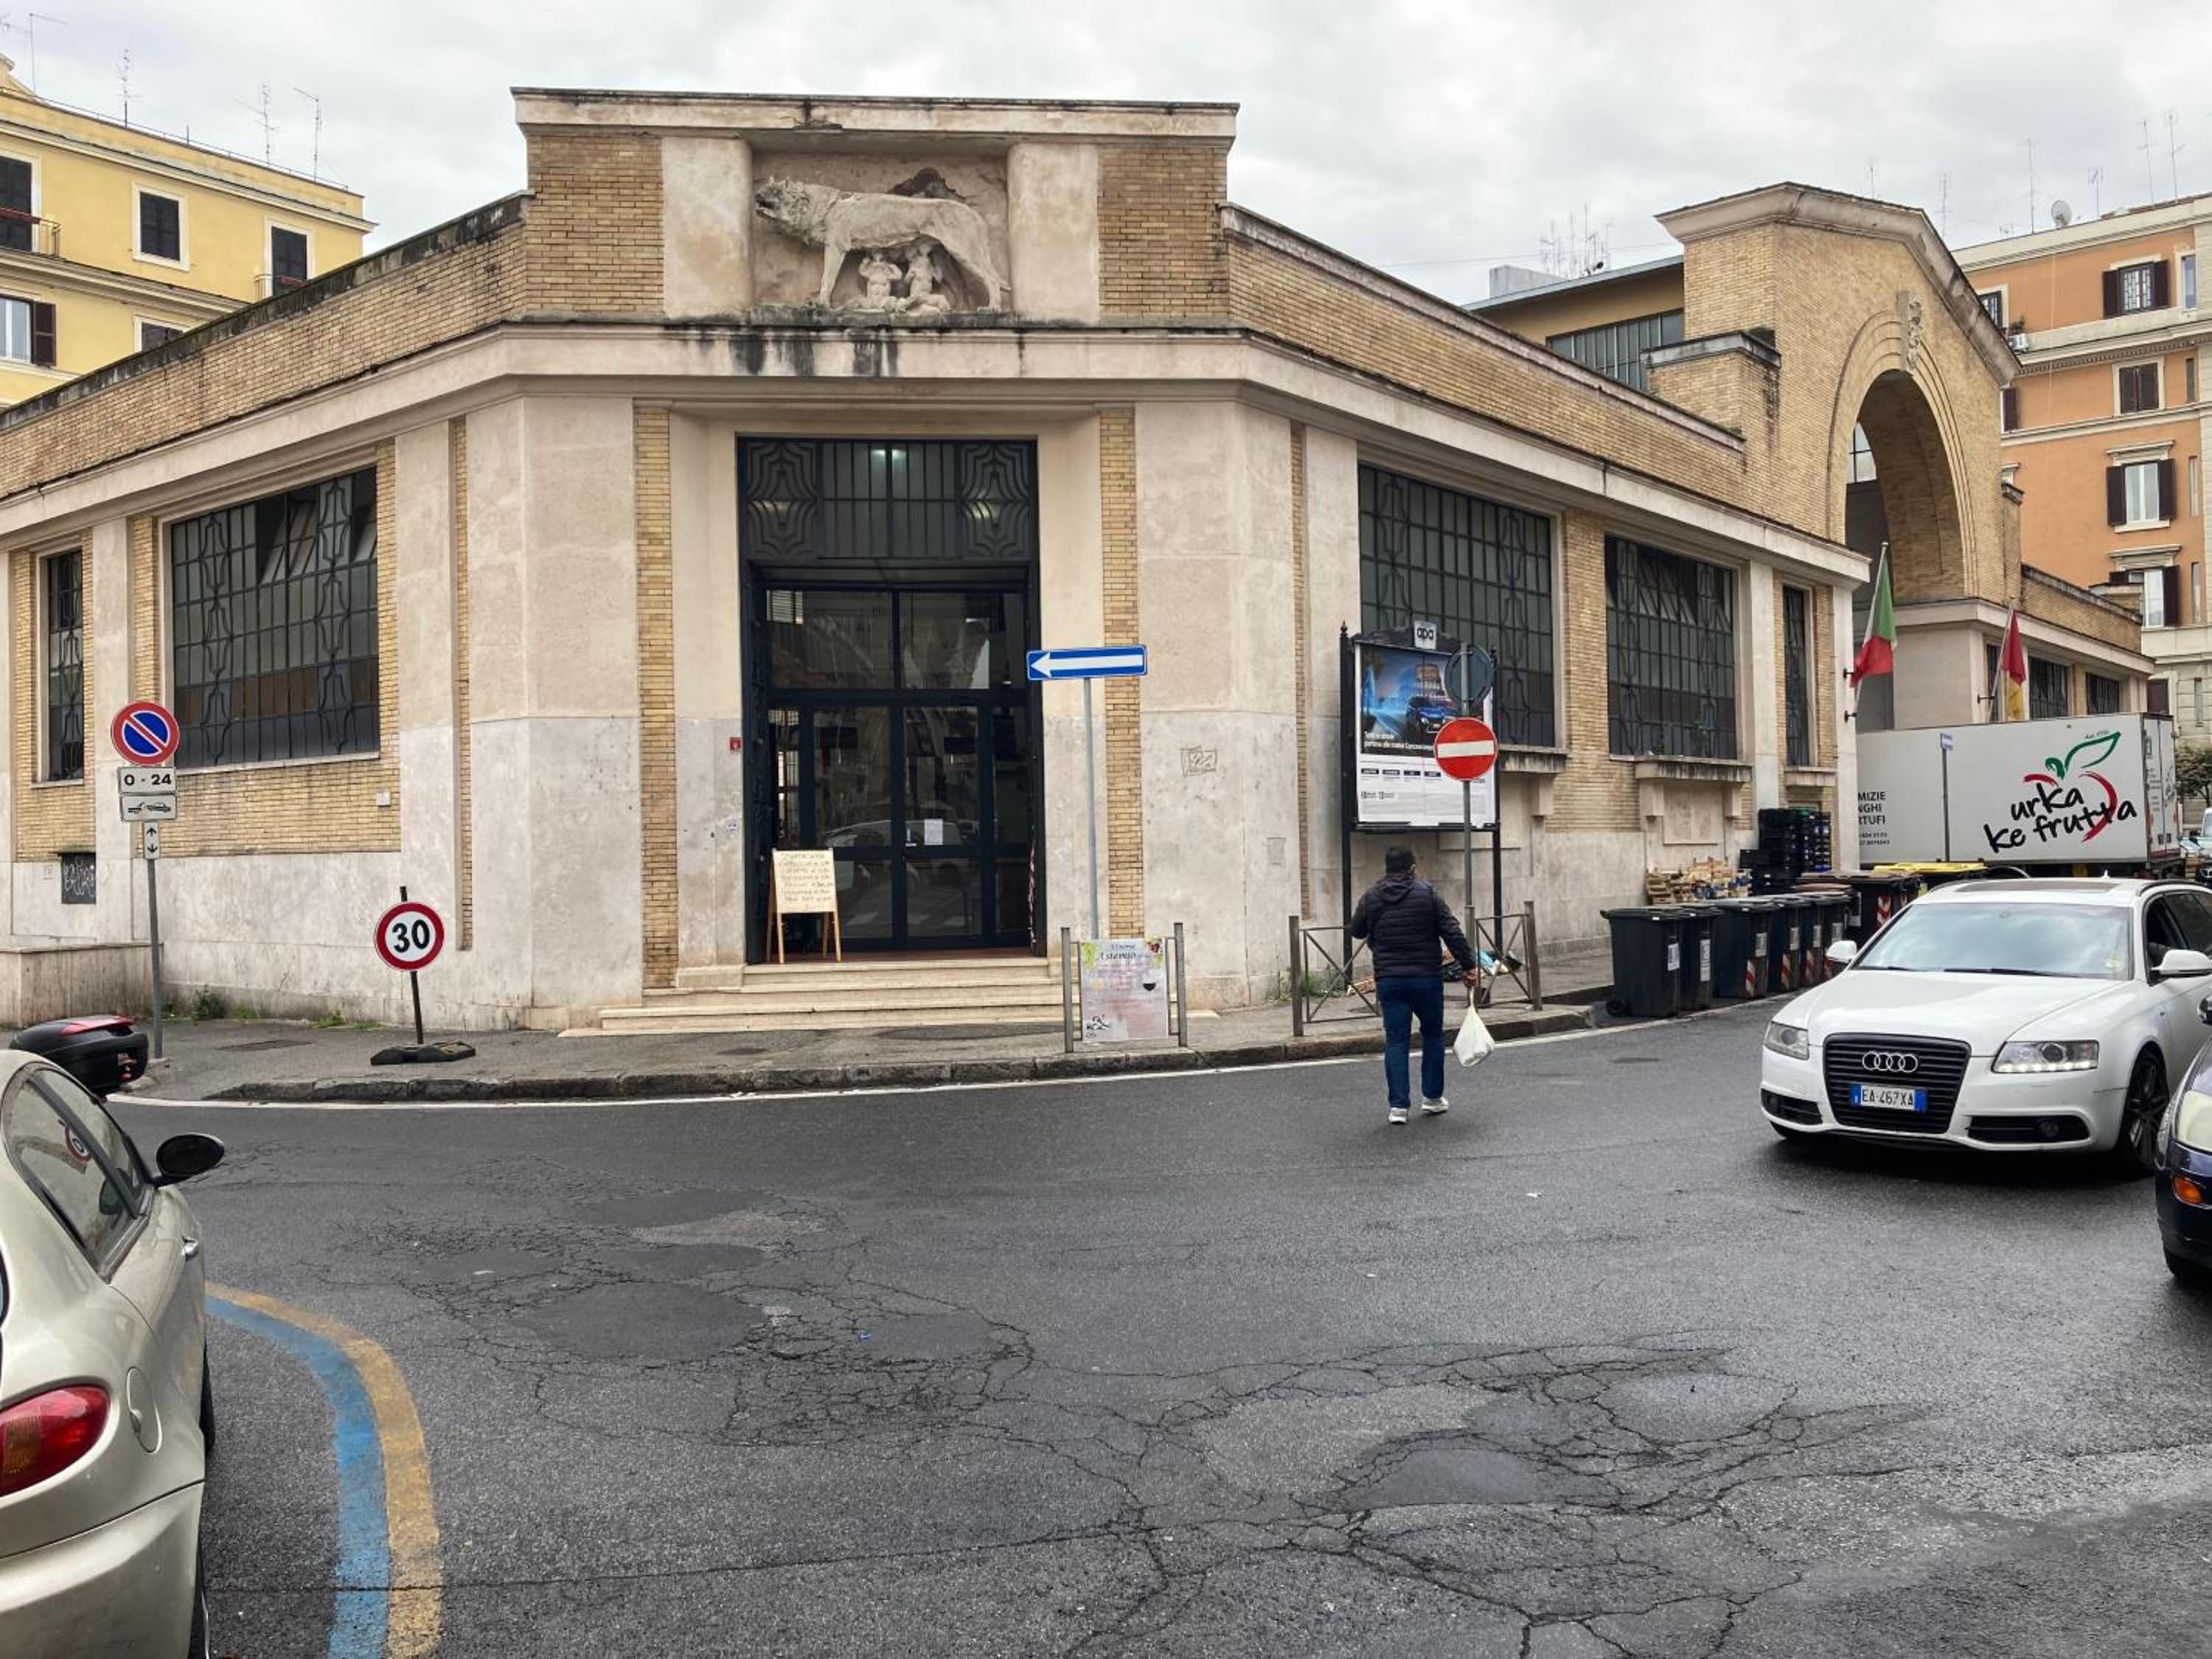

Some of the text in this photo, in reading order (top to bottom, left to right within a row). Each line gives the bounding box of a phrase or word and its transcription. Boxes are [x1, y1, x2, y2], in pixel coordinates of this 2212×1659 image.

[151, 773, 172, 785] 24
[2011, 783, 2084, 821] urka
[2033, 800, 2138, 842] frutta
[1983, 824, 2026, 854] ke
[392, 919, 430, 953] 30
